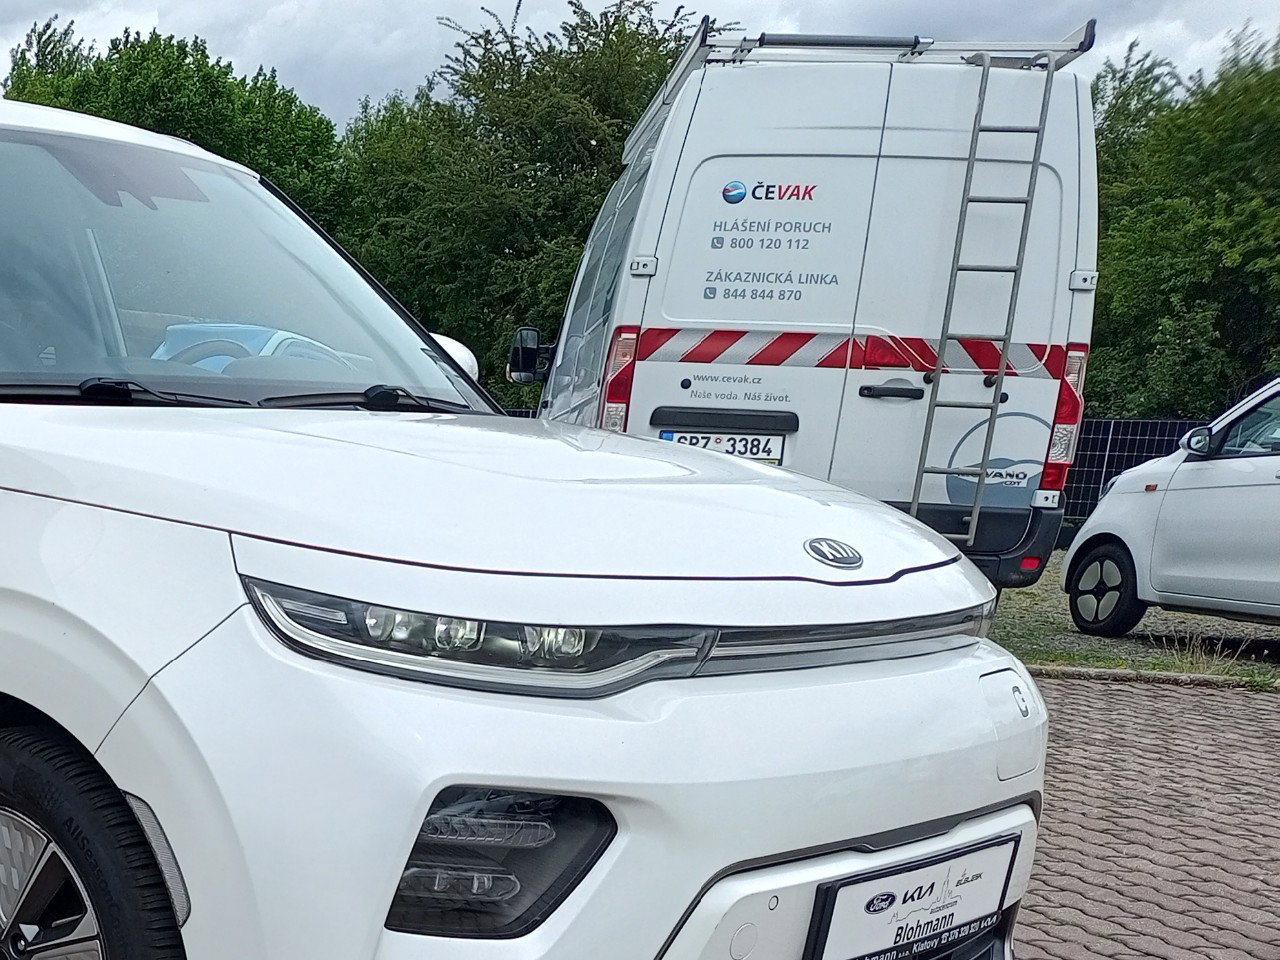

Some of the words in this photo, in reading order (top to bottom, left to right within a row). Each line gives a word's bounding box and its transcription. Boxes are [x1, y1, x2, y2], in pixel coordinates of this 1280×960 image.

[751, 181, 818, 201] ČEVAK
[713, 219, 772, 232] HLÁŠENÍ
[774, 221, 832, 234] PORUCH
[730, 238, 754, 249] 800
[759, 238, 781, 250] 120
[786, 239, 809, 250] 112
[705, 269, 794, 284] ZÁKAZNICKÁ
[797, 274, 839, 286] LINKA
[723, 289, 746, 300] 844
[750, 289, 774, 301] 844
[778, 290, 802, 301] 870
[693, 375, 762, 385] www.cevak.cz
[690, 390, 713, 399] Naše
[725, 437, 773, 457] 3384
[902, 882, 936, 905] KIA
[893, 912, 955, 946] Blohmann
[912, 937, 940, 954] Klatovy
